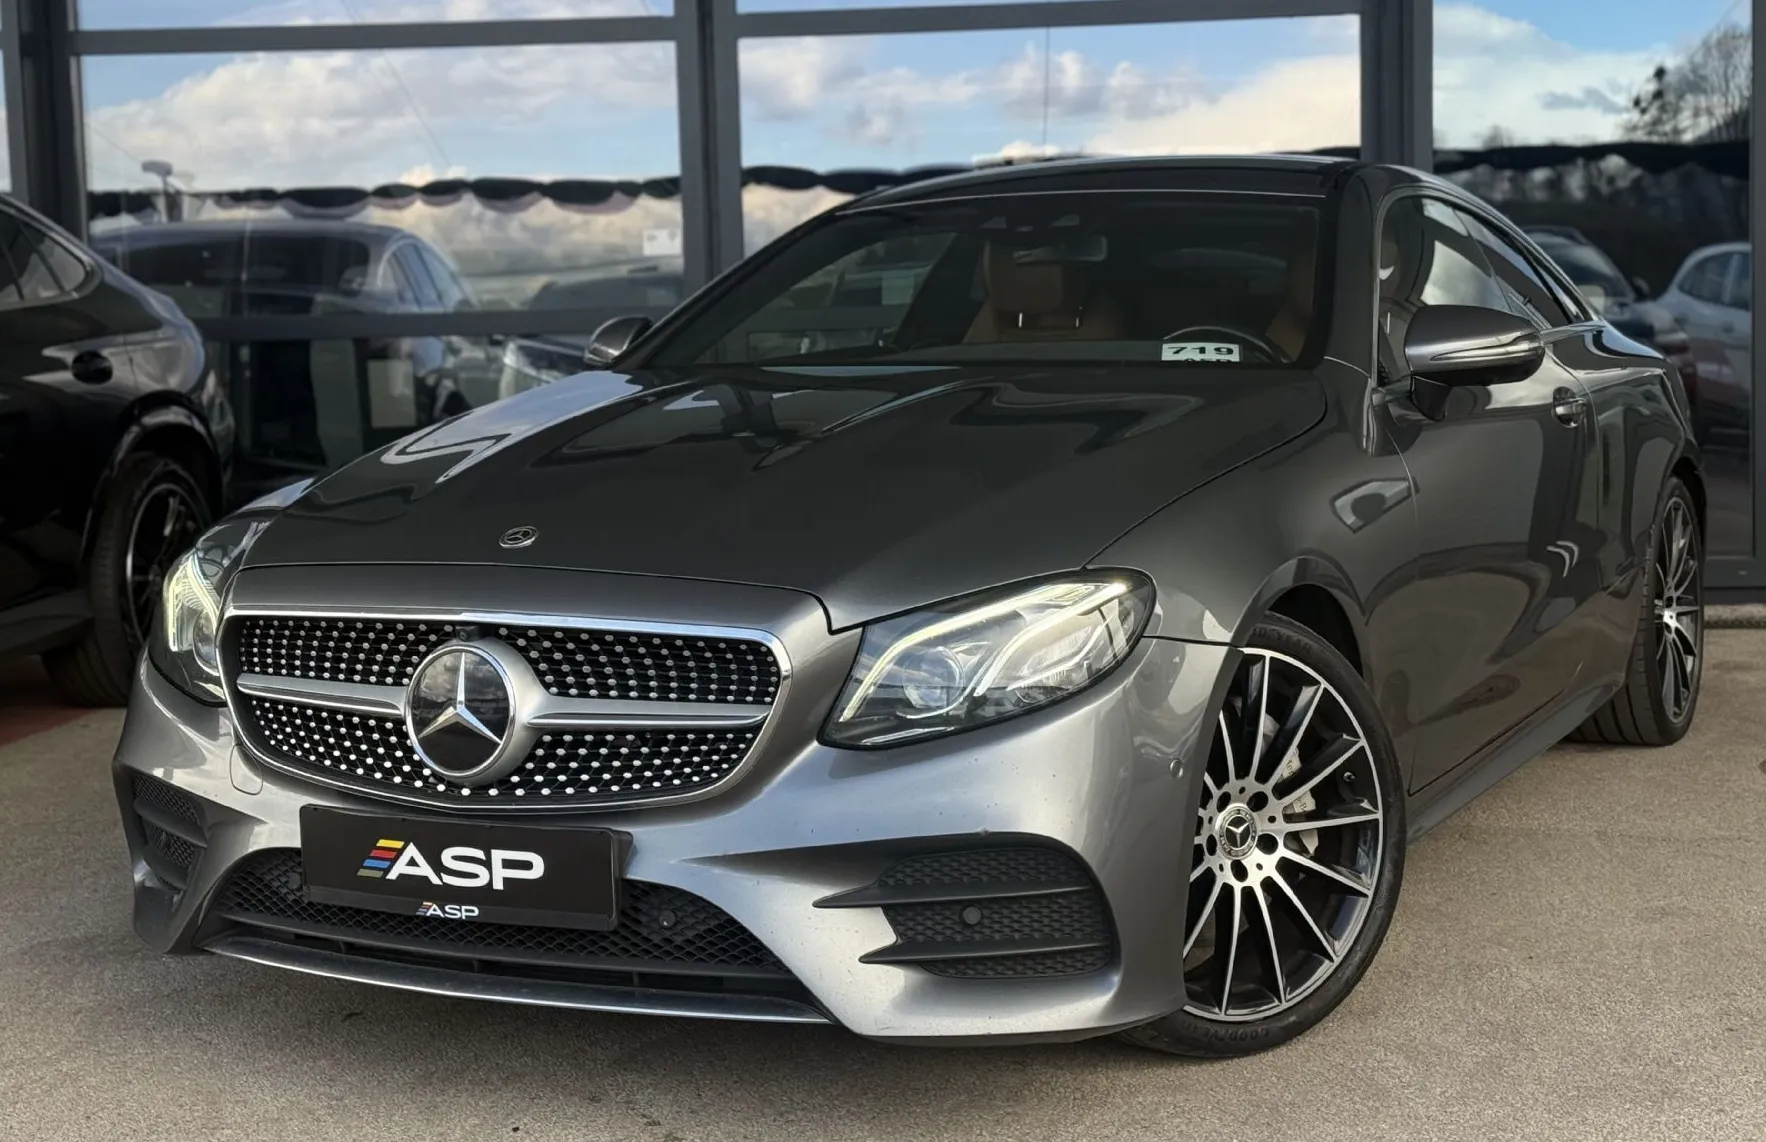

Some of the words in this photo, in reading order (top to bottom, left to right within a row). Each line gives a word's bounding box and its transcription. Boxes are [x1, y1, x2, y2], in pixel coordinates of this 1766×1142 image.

[1168, 346, 1234, 356] 719
[386, 841, 545, 891] ASP
[425, 902, 479, 920] ASP
